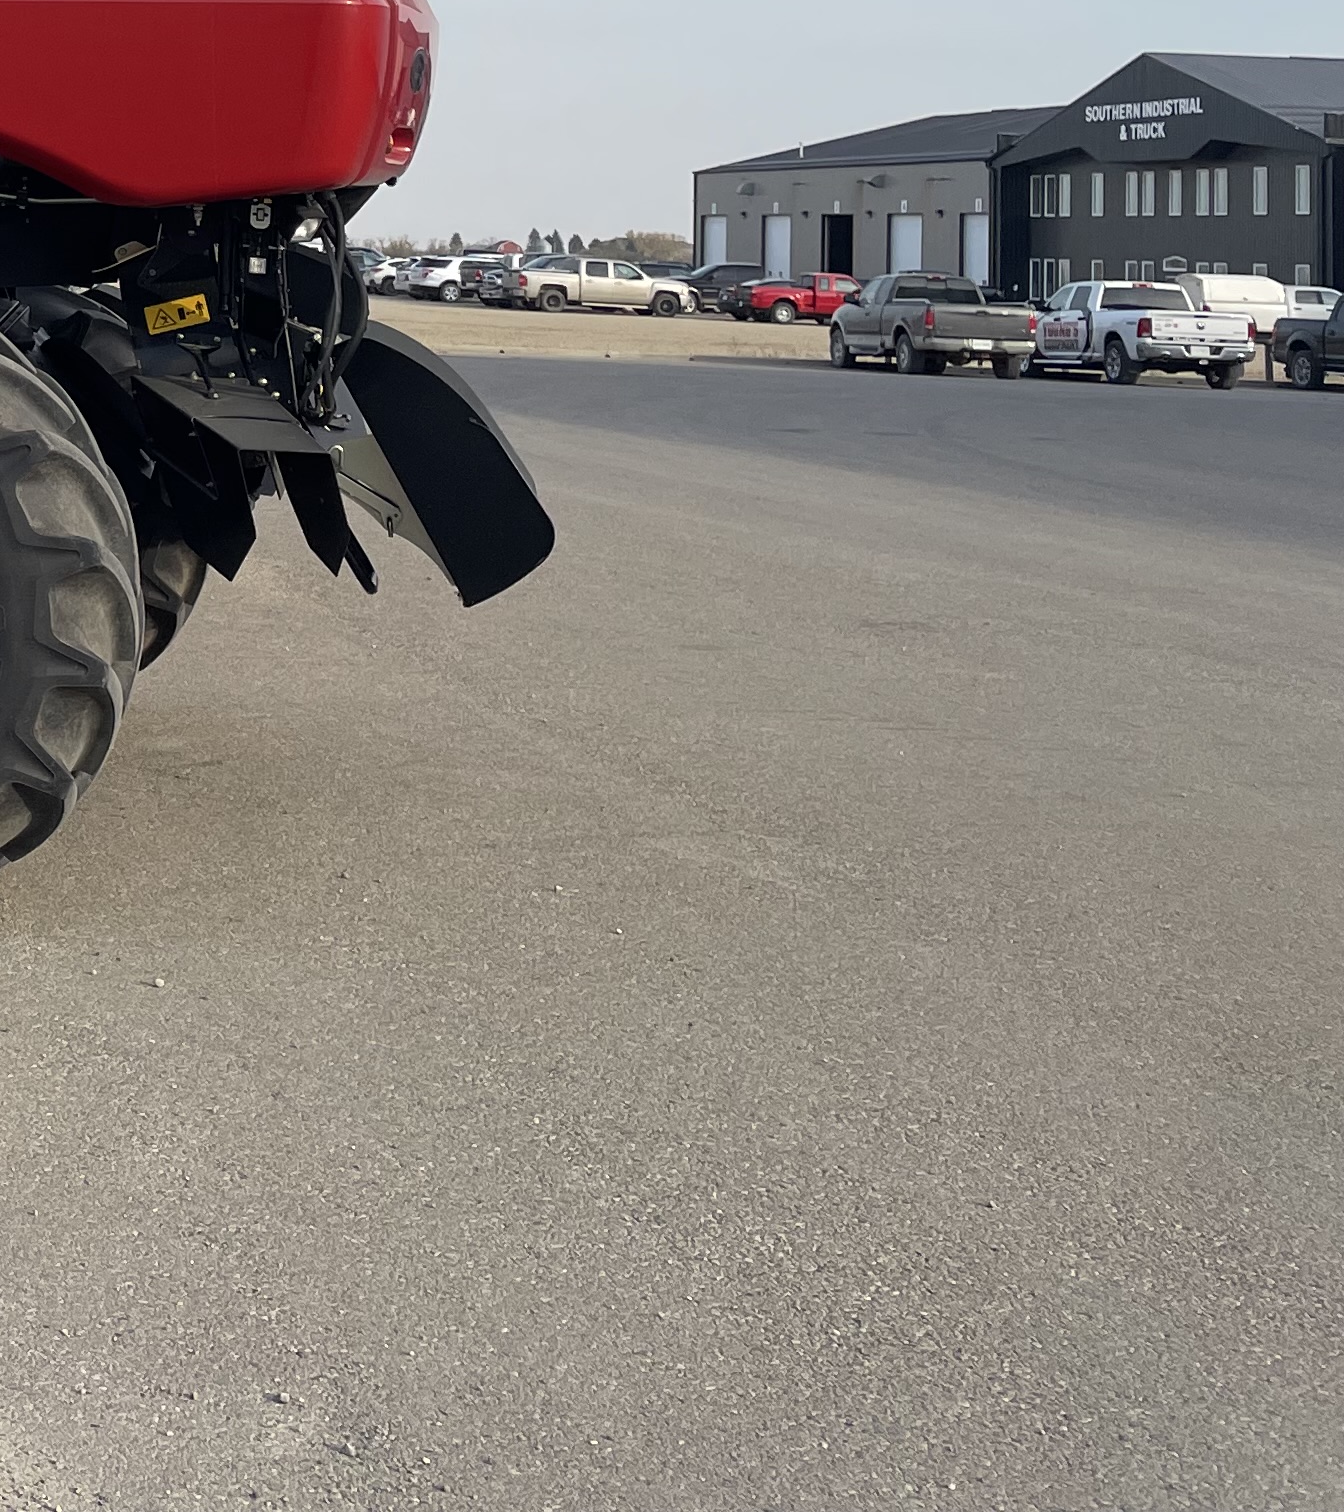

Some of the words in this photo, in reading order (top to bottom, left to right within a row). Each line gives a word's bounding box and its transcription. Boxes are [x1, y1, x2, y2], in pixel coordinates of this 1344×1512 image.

[1084, 103, 1141, 123] SOUTHERN
[1141, 96, 1204, 118] INDUSTRIAL
[1119, 124, 1128, 141] &
[1130, 121, 1166, 141] TRUCK
